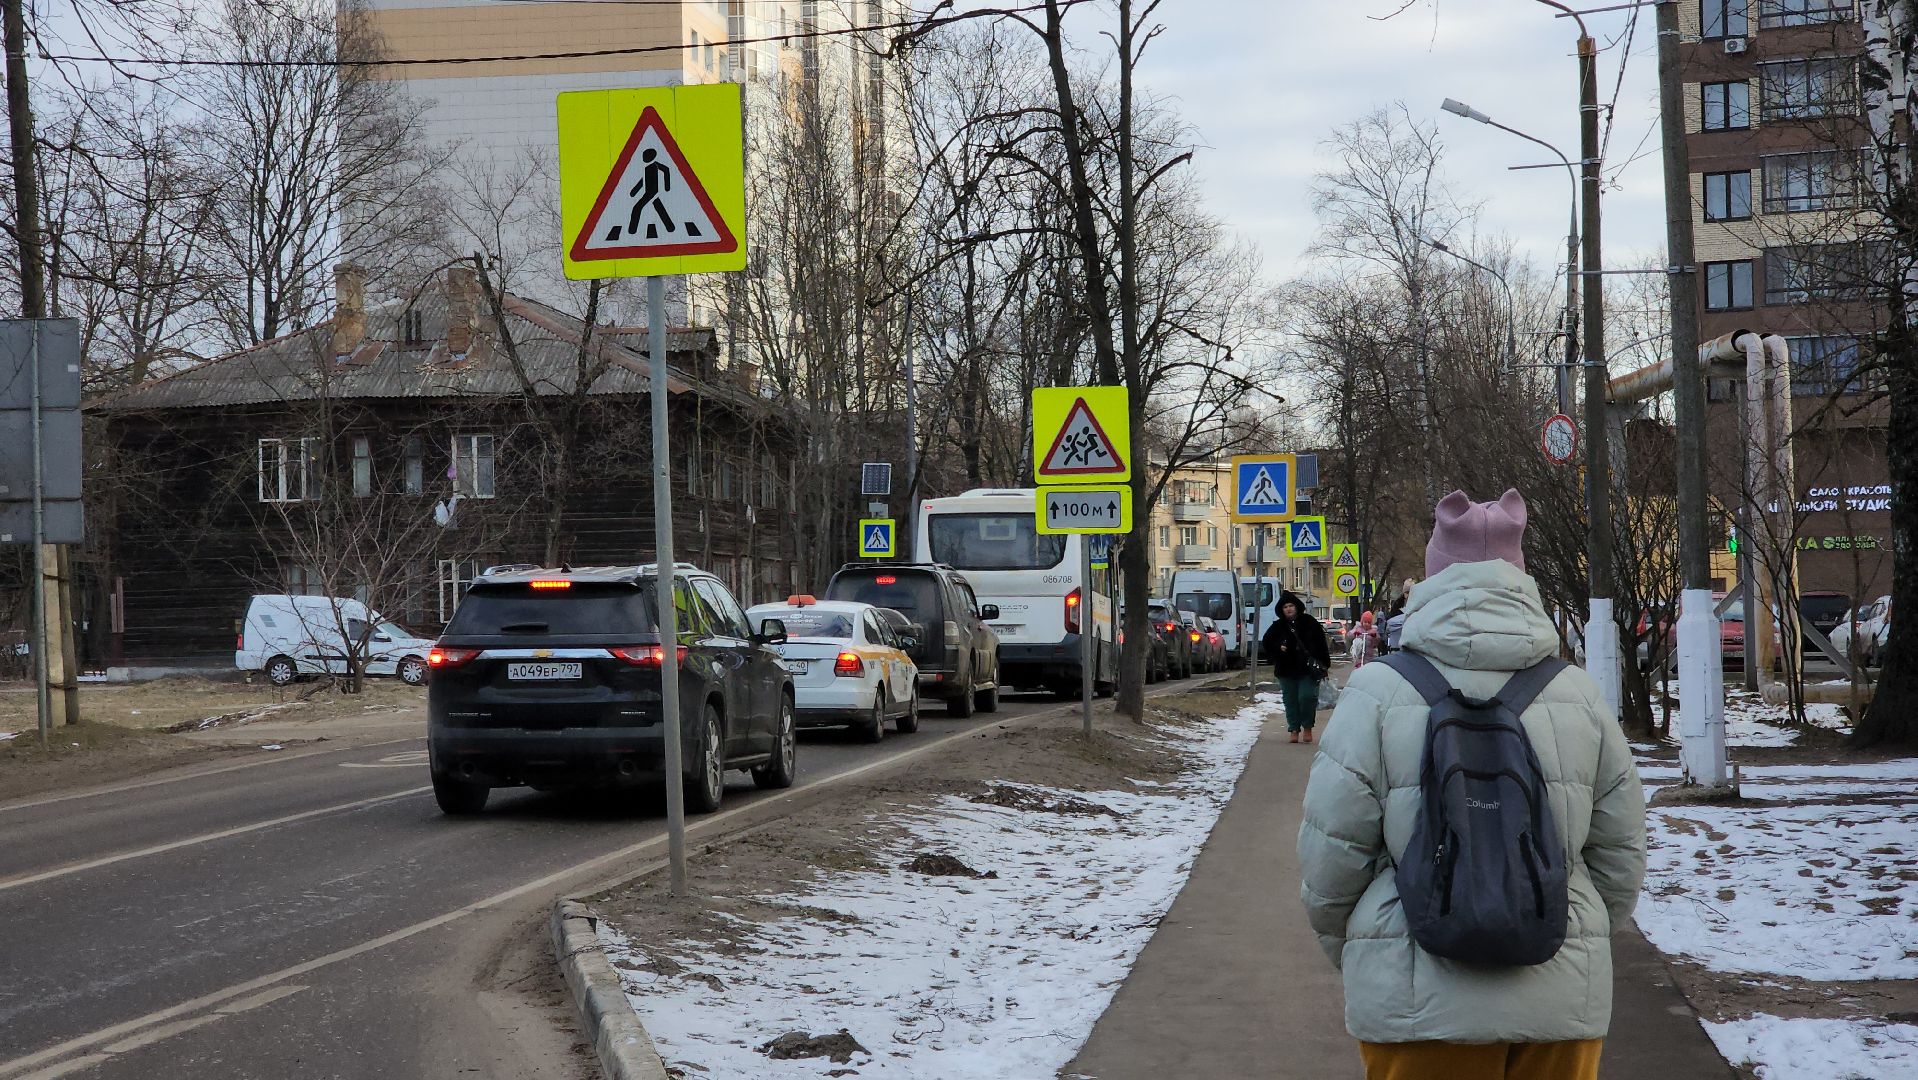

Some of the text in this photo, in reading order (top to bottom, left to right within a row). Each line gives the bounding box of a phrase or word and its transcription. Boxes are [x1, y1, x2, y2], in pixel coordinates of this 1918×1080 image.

[1809, 487, 1846, 497] САЛО
[1042, 575, 1073, 584] 086708
[1342, 578, 1353, 587] 40
[560, 663, 579, 673] 797
[796, 661, 806, 669] 40
